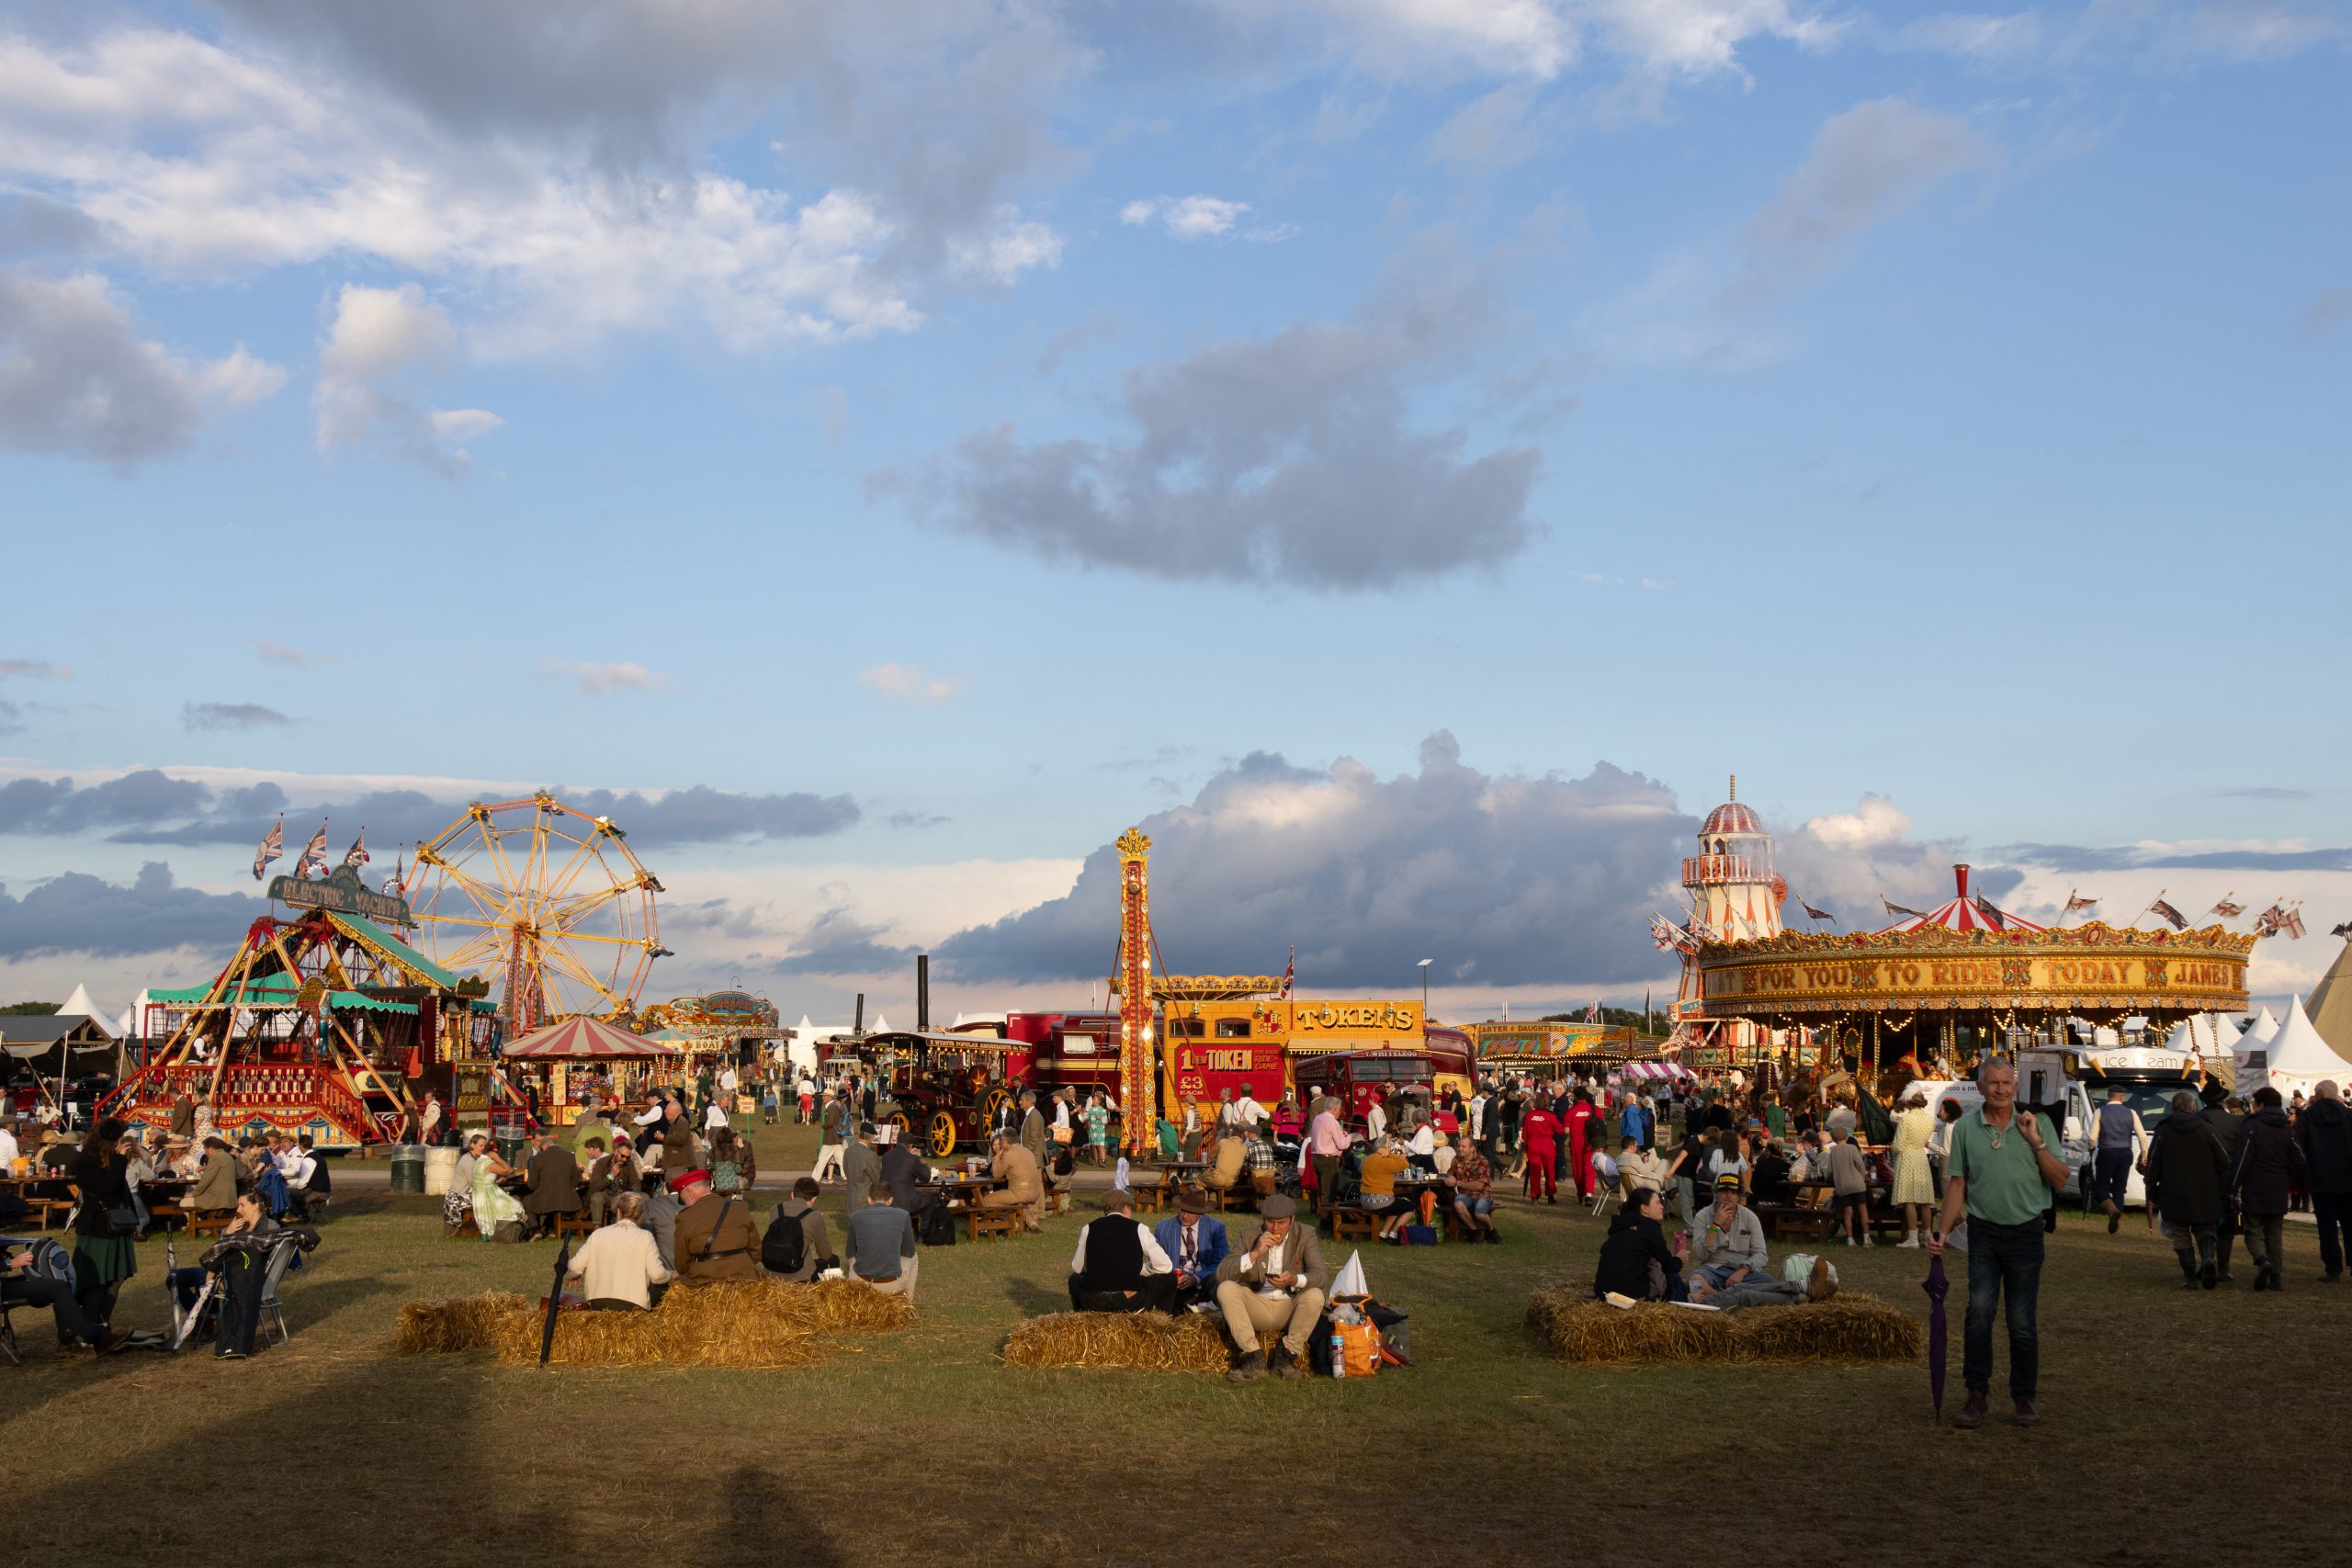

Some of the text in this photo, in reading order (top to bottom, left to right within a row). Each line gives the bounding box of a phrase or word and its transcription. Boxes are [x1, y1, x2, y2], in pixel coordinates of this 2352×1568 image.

[283, 879, 401, 917] ELECTRIC YACHTS
[1759, 967, 1795, 989] FOR
[1803, 966, 1849, 987] YOU
[1884, 964, 1921, 987] TO
[1931, 963, 2000, 986] RIDE
[2042, 961, 2132, 984] TODAY
[2174, 963, 2229, 986] JAMES
[1297, 1007, 1413, 1031] TOKENS
[1518, 1023, 1565, 1033] DAUGHTERS
[1182, 1049, 1193, 1071] 1
[1205, 1049, 1253, 1072] TOKEN
[1255, 1055, 1273, 1063] RIDE
[2105, 1055, 2178, 1069] ice eam
[1255, 1063, 1279, 1071] GAME
[1180, 1076, 1204, 1089] £3
[149, 1117, 172, 1126] ORIGI
[274, 1116, 303, 1124] YACHTS
